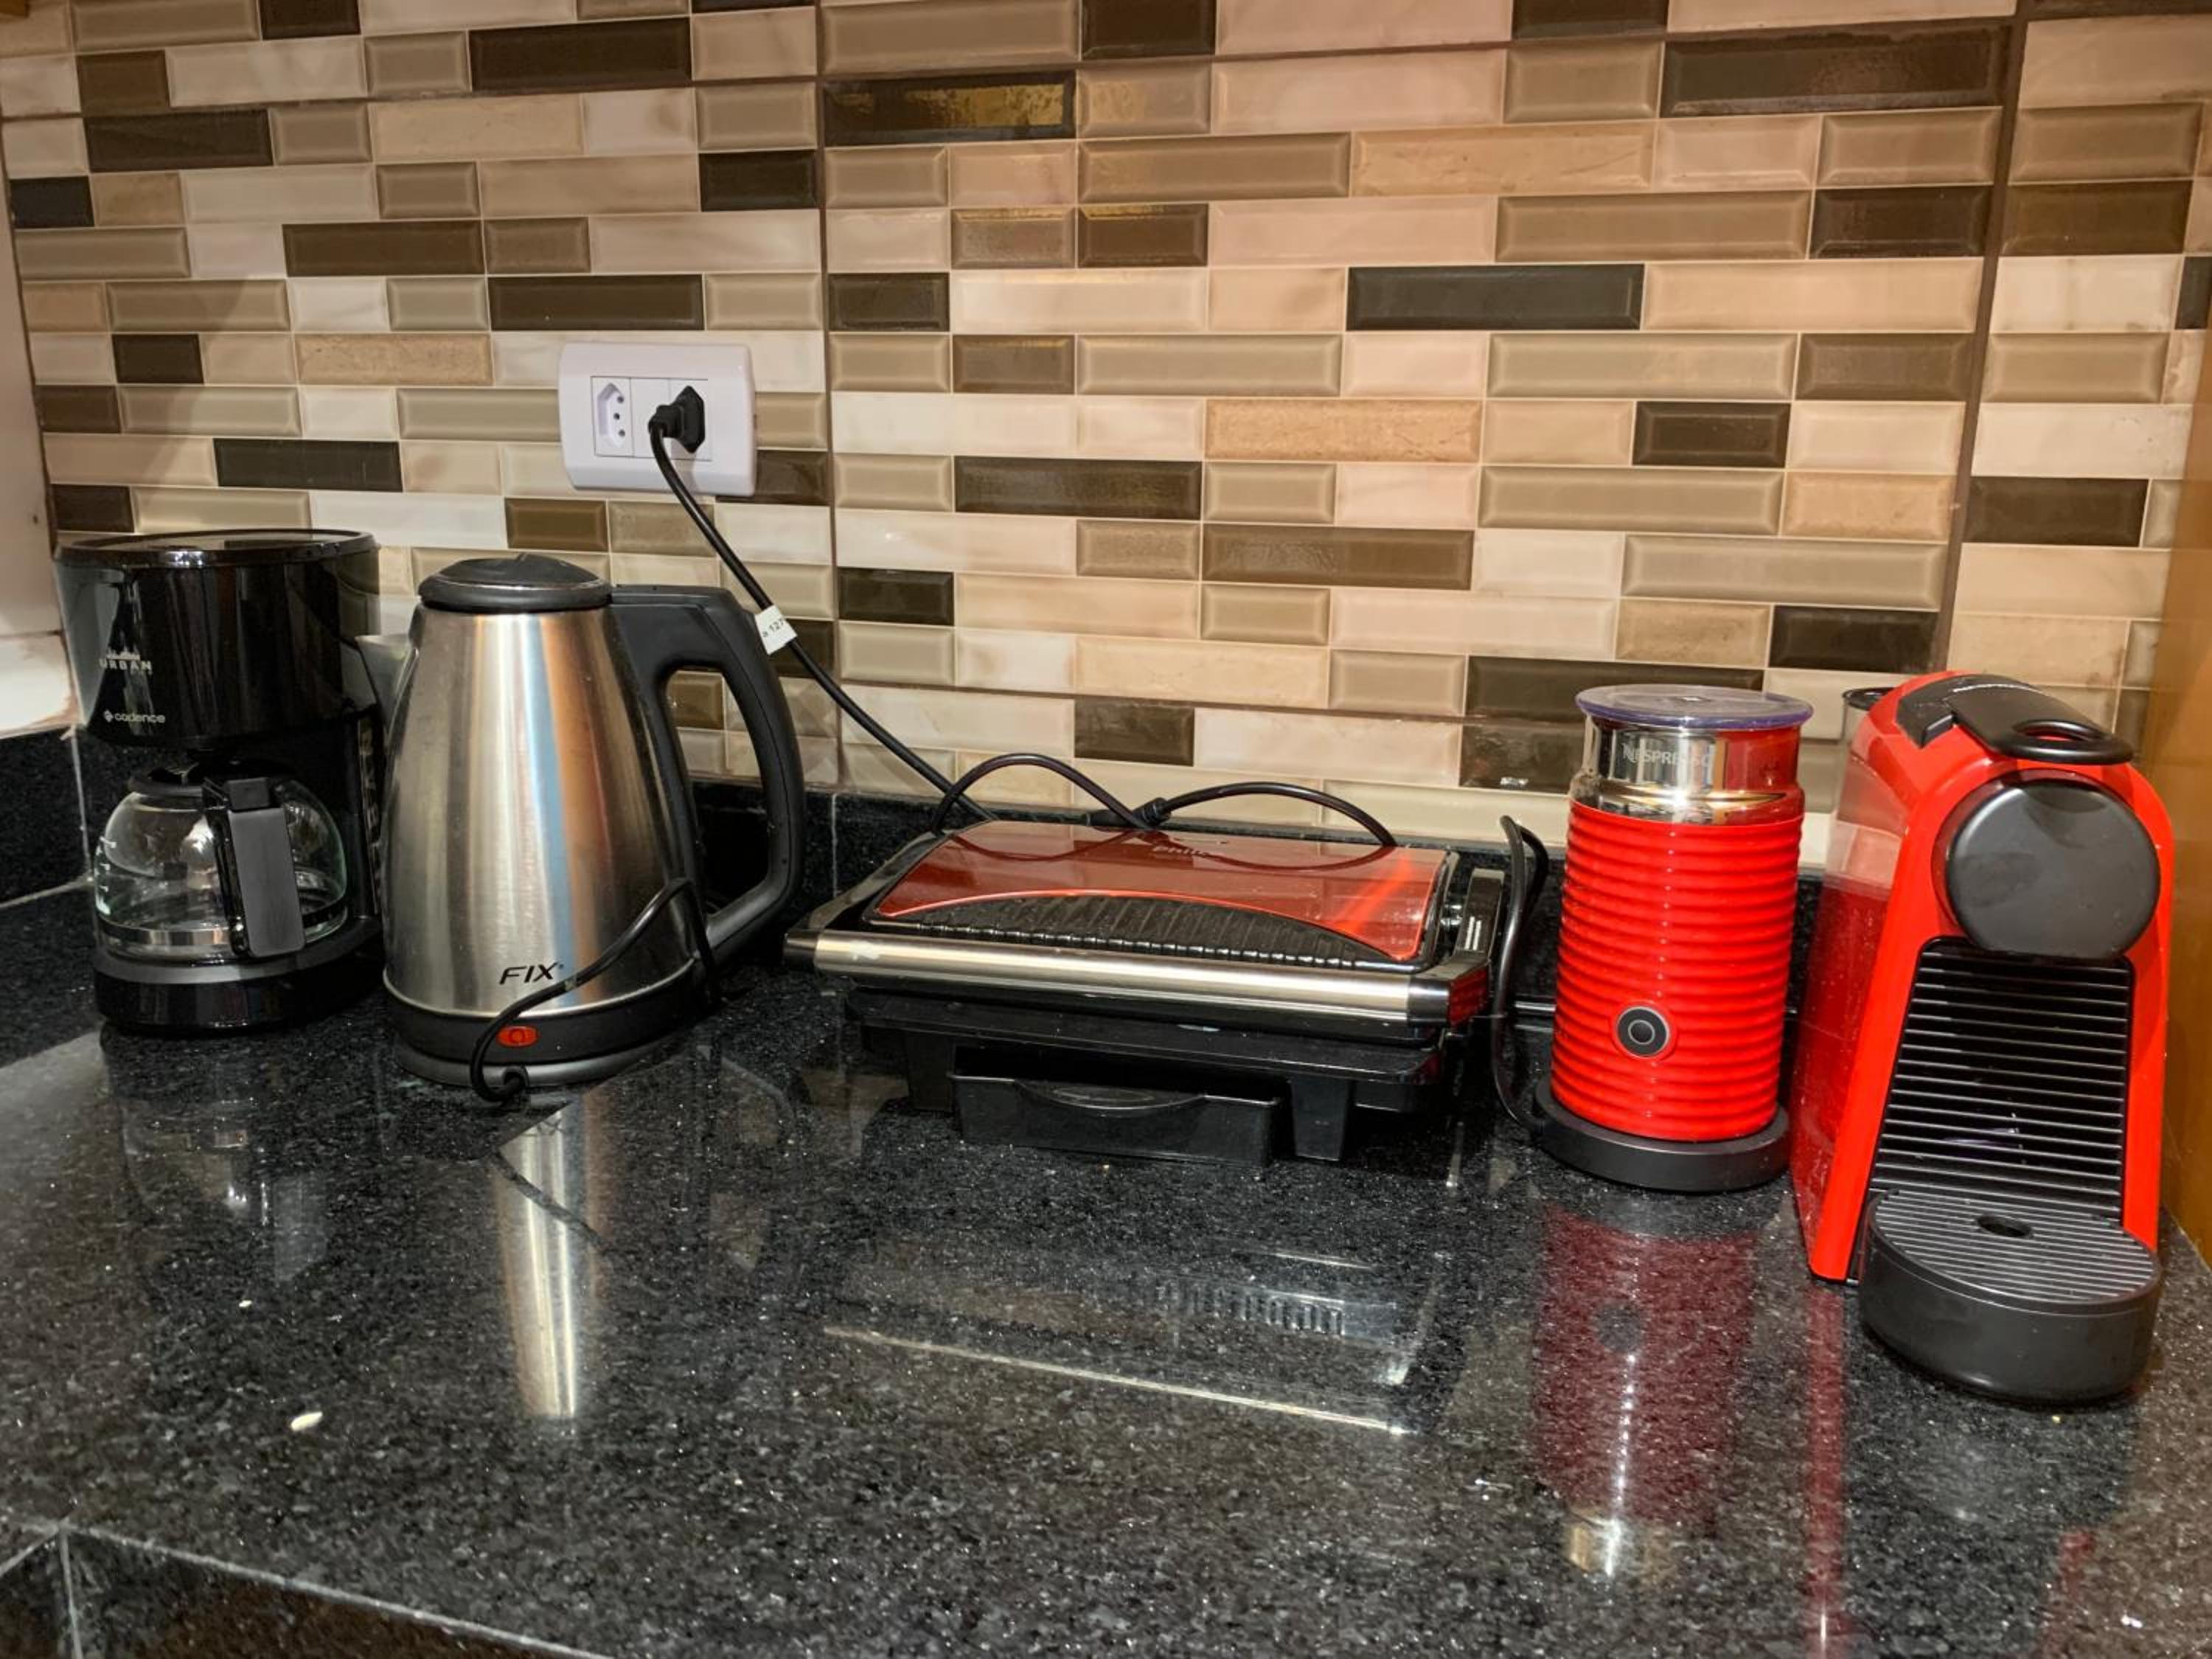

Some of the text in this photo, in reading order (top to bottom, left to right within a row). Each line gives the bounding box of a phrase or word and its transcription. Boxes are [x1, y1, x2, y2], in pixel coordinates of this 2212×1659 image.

[99, 658, 152, 670] URBAN
[114, 711, 166, 723] cadence
[498, 961, 559, 986] FIX
